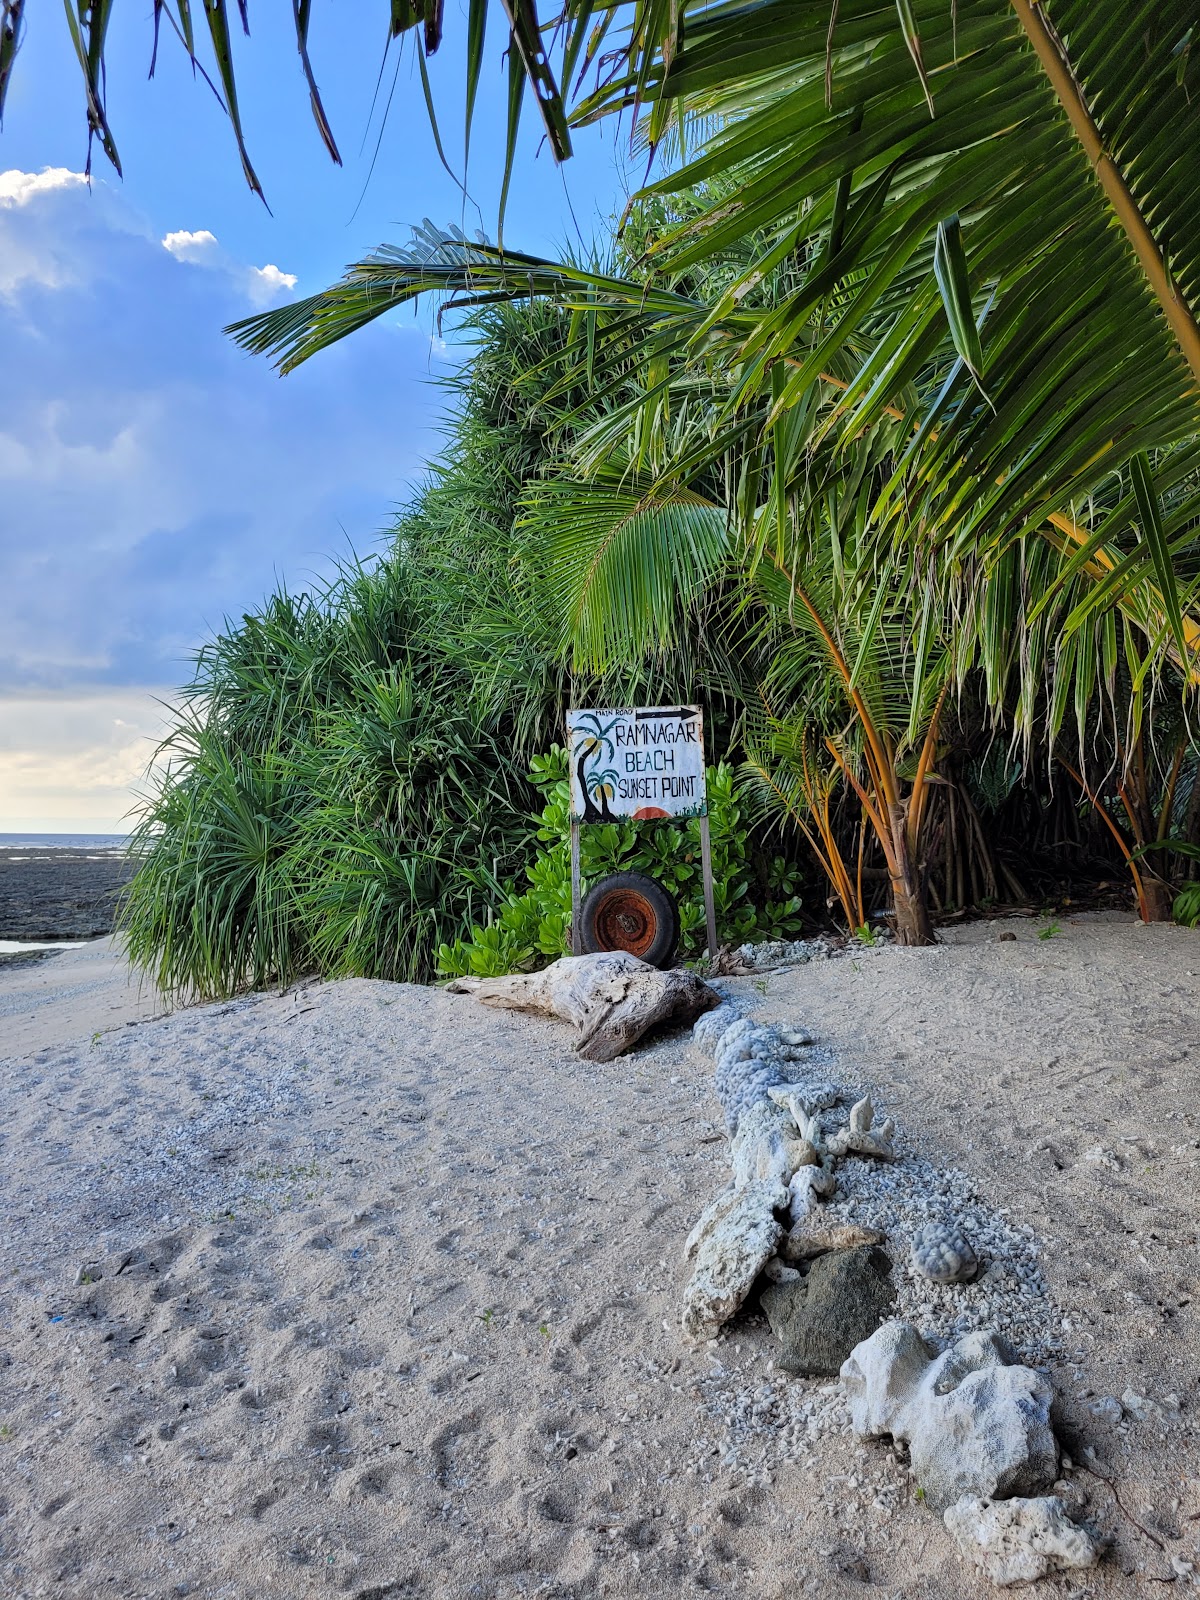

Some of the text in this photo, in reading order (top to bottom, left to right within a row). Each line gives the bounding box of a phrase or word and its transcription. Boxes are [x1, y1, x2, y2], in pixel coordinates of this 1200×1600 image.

[615, 721, 698, 747] RAMNAGAR
[625, 749, 675, 773] BEACH
[618, 775, 697, 799] SUNSET POINT
